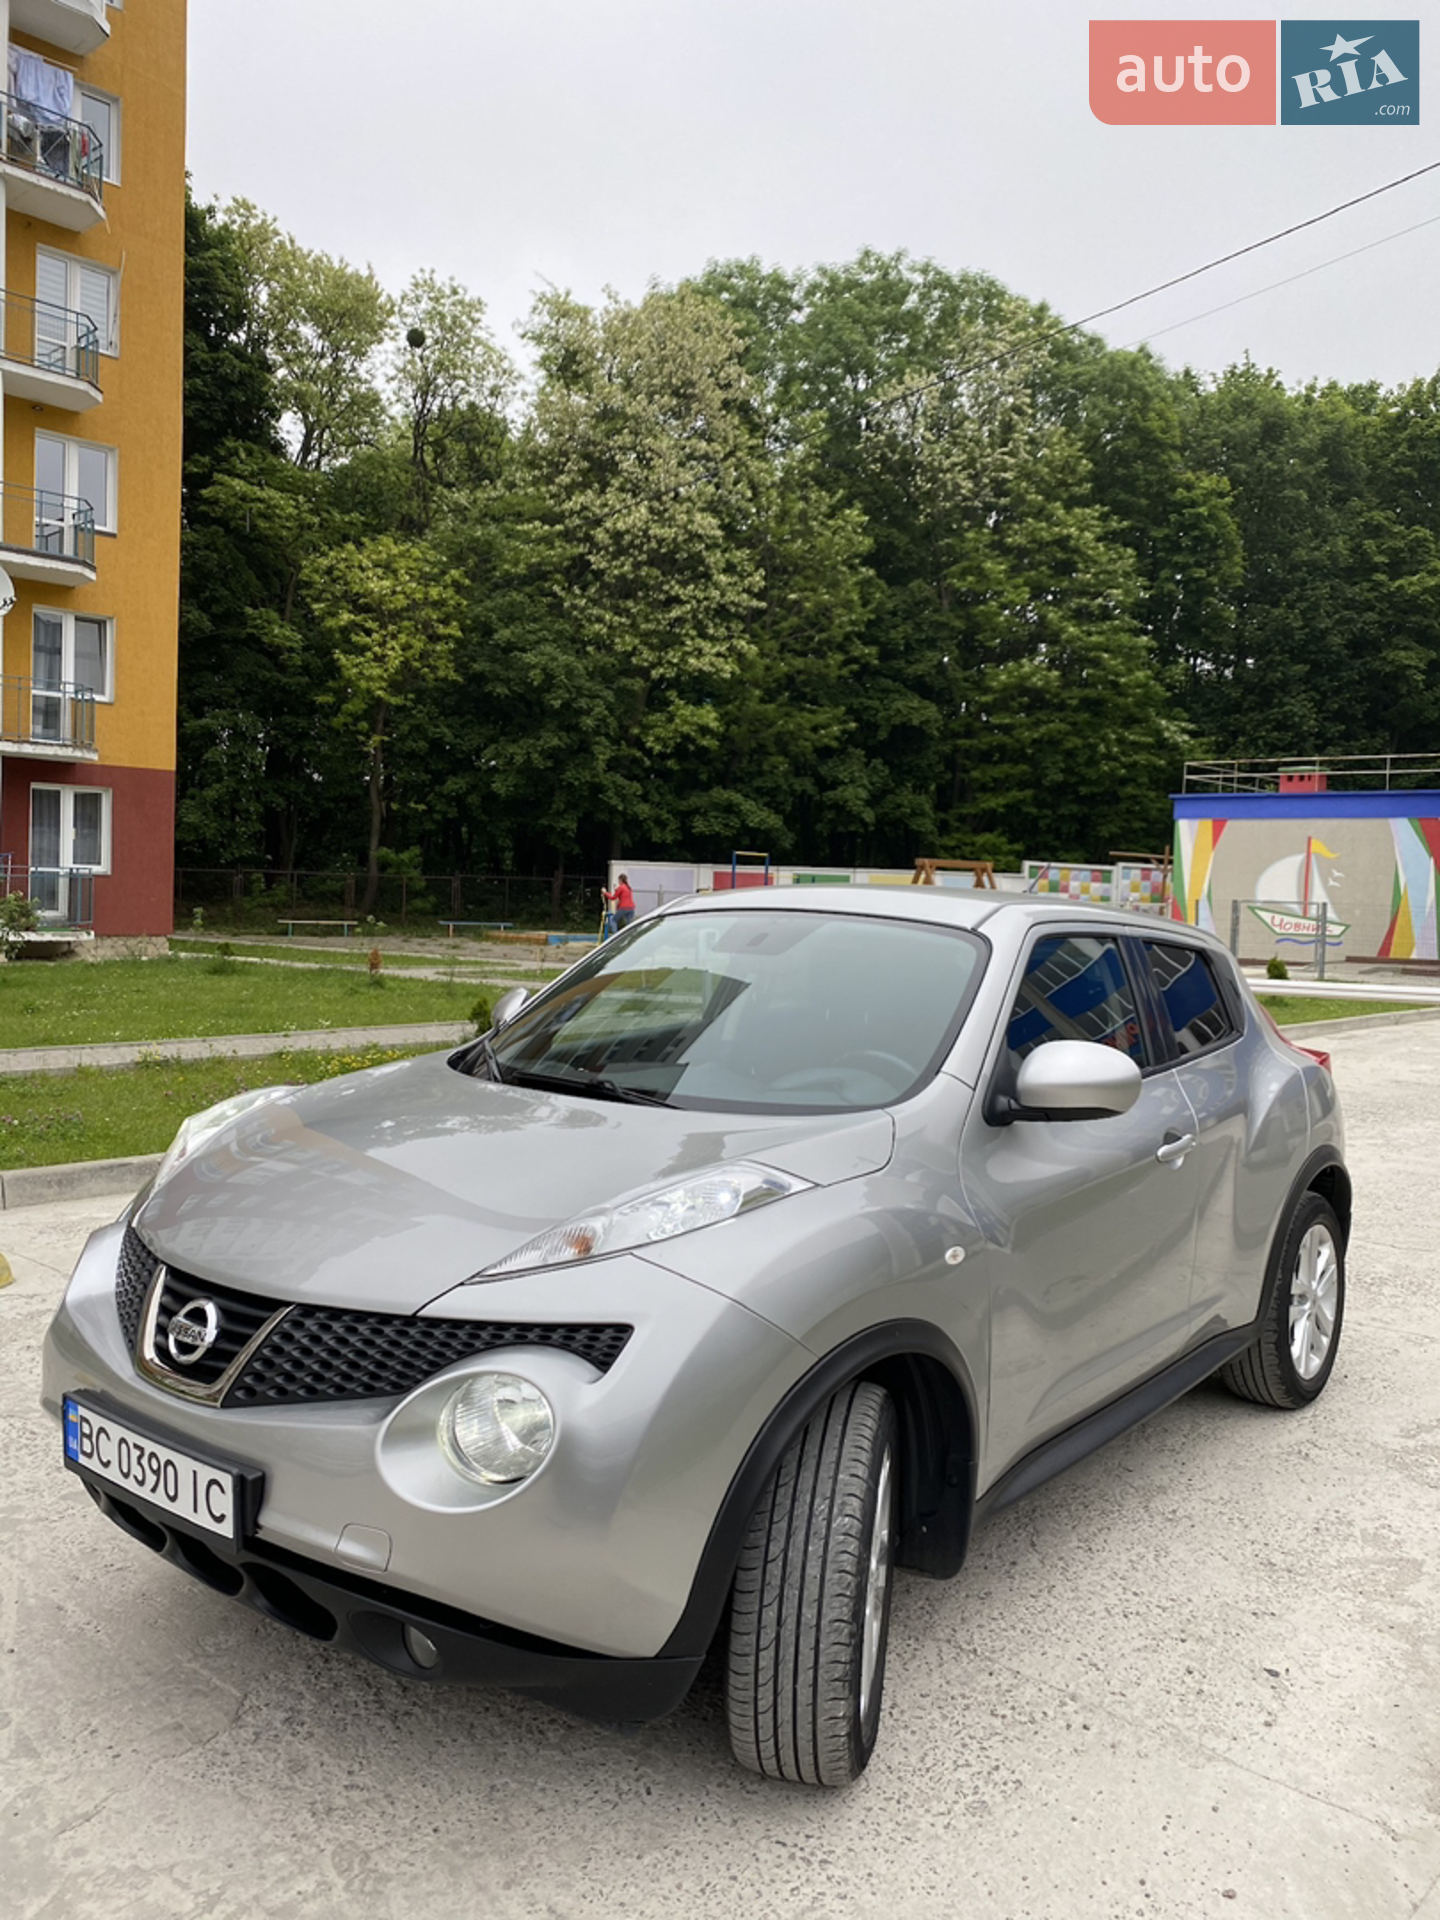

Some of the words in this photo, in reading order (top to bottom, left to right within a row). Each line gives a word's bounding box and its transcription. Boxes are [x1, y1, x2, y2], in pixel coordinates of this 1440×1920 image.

[79, 1414, 112, 1469] BC
[118, 1436, 179, 1503] 0390
[192, 1469, 227, 1524] IC
